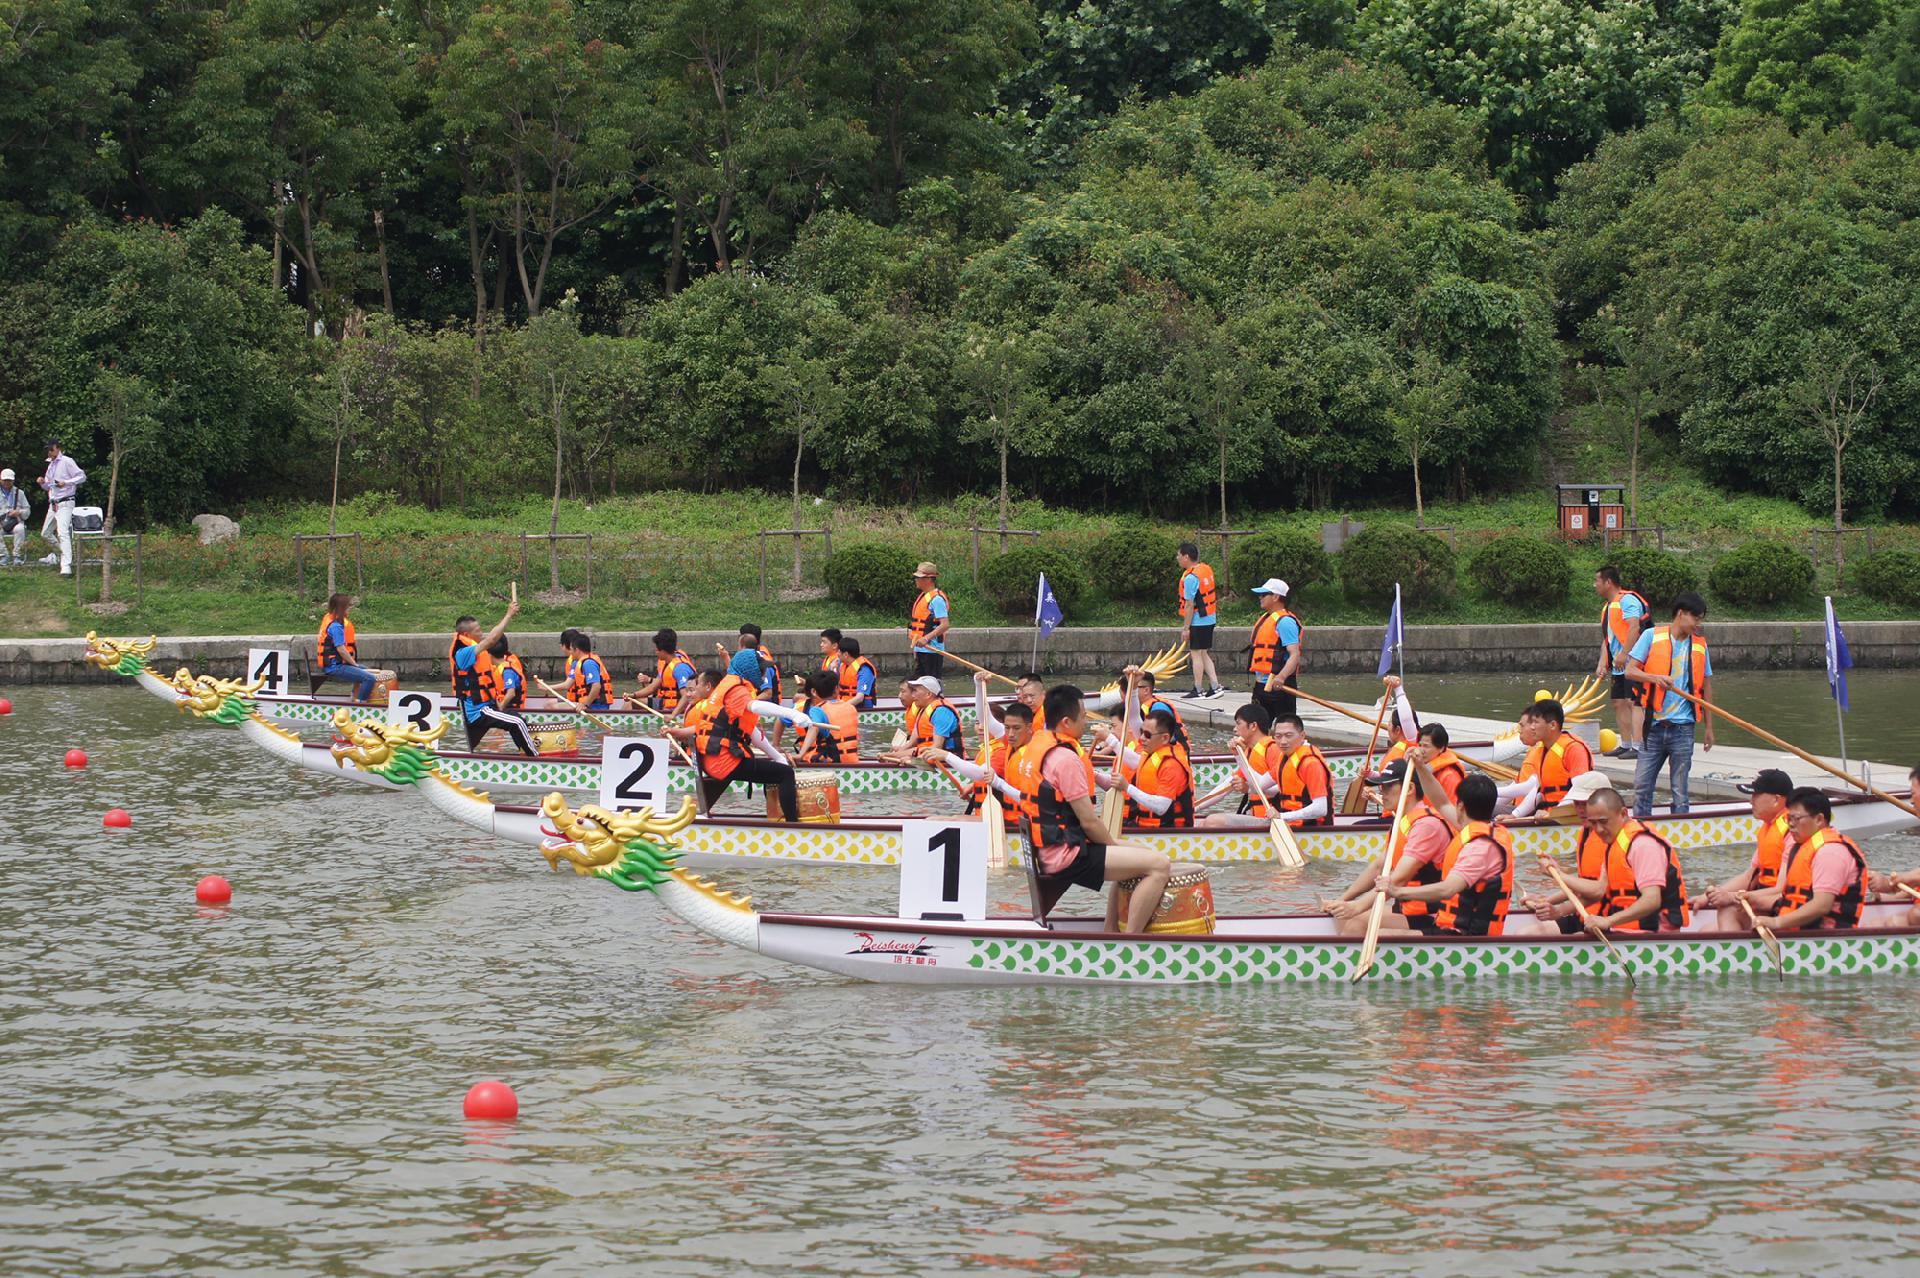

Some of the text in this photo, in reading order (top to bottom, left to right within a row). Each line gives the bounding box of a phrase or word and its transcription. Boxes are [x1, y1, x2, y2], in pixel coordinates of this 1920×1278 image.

[253, 651, 283, 690] 4
[398, 693, 432, 732] 3
[615, 742, 655, 800] 2
[928, 827, 961, 902] 1
